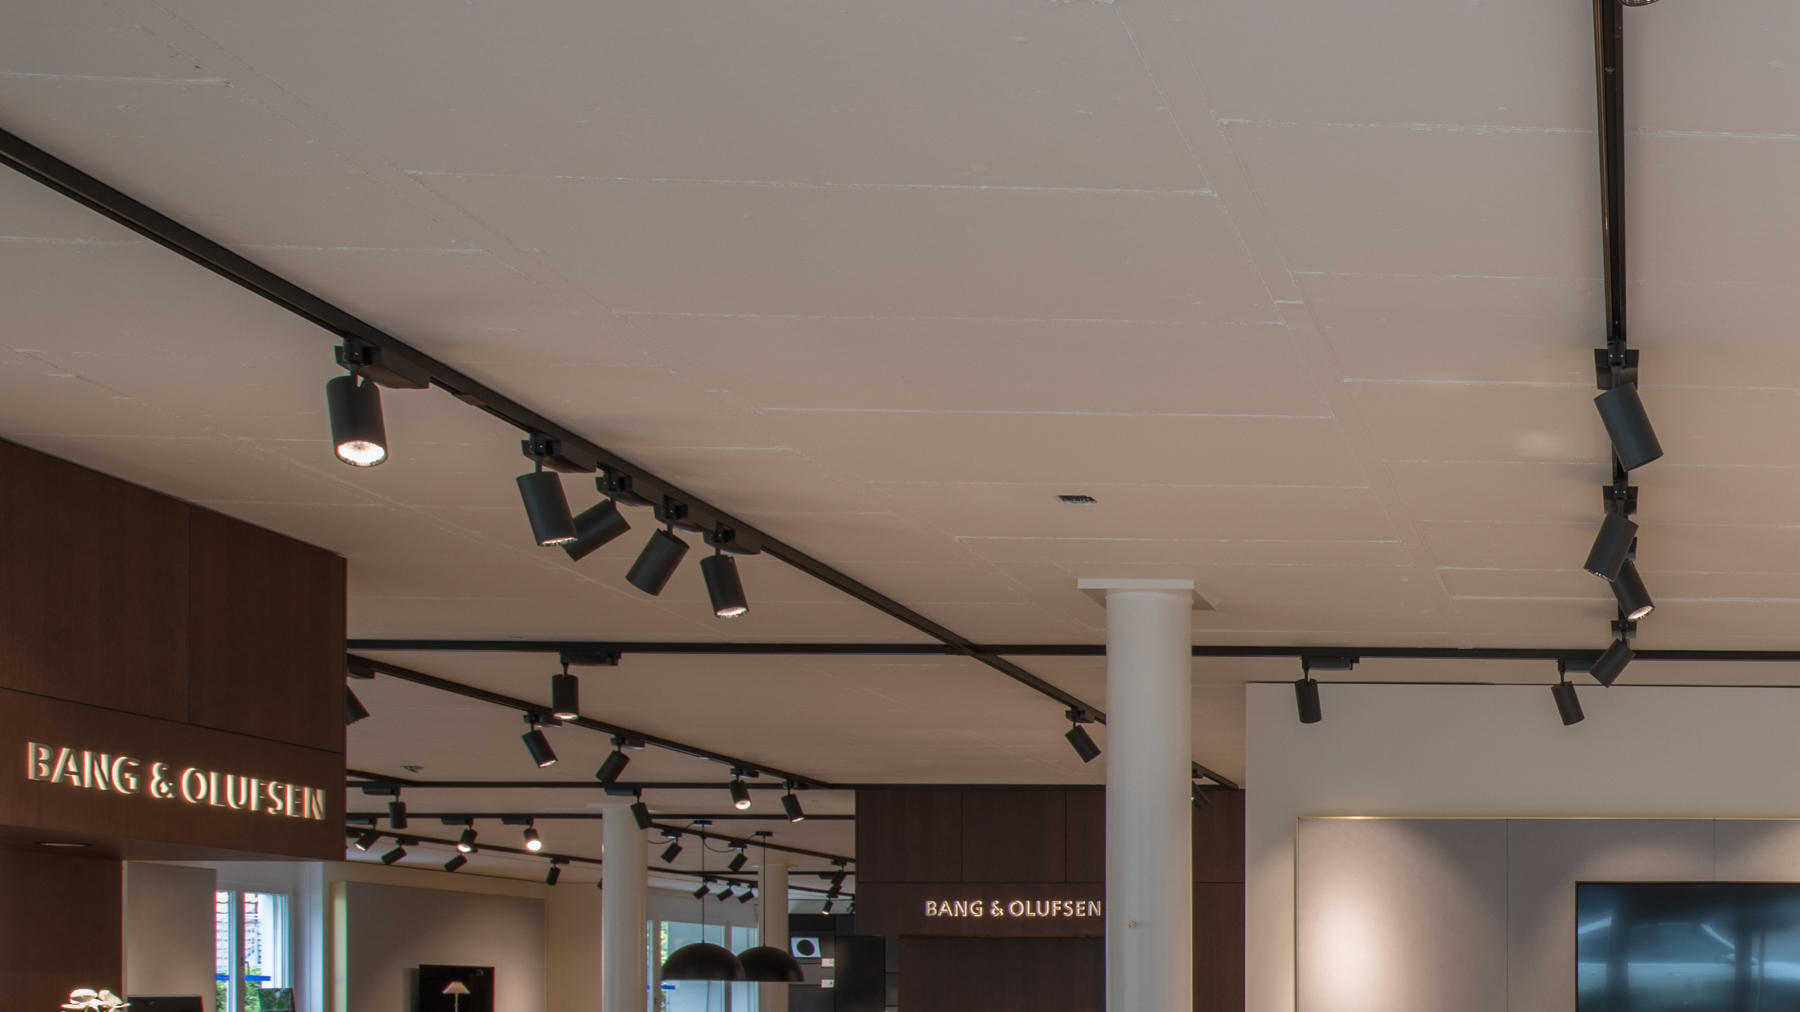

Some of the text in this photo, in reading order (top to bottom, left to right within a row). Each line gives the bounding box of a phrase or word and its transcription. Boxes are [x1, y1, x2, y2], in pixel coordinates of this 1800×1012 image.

[27, 741, 326, 821] BANG & OLUFSEN
[925, 900, 1102, 917] BANG & OLUFSEN
